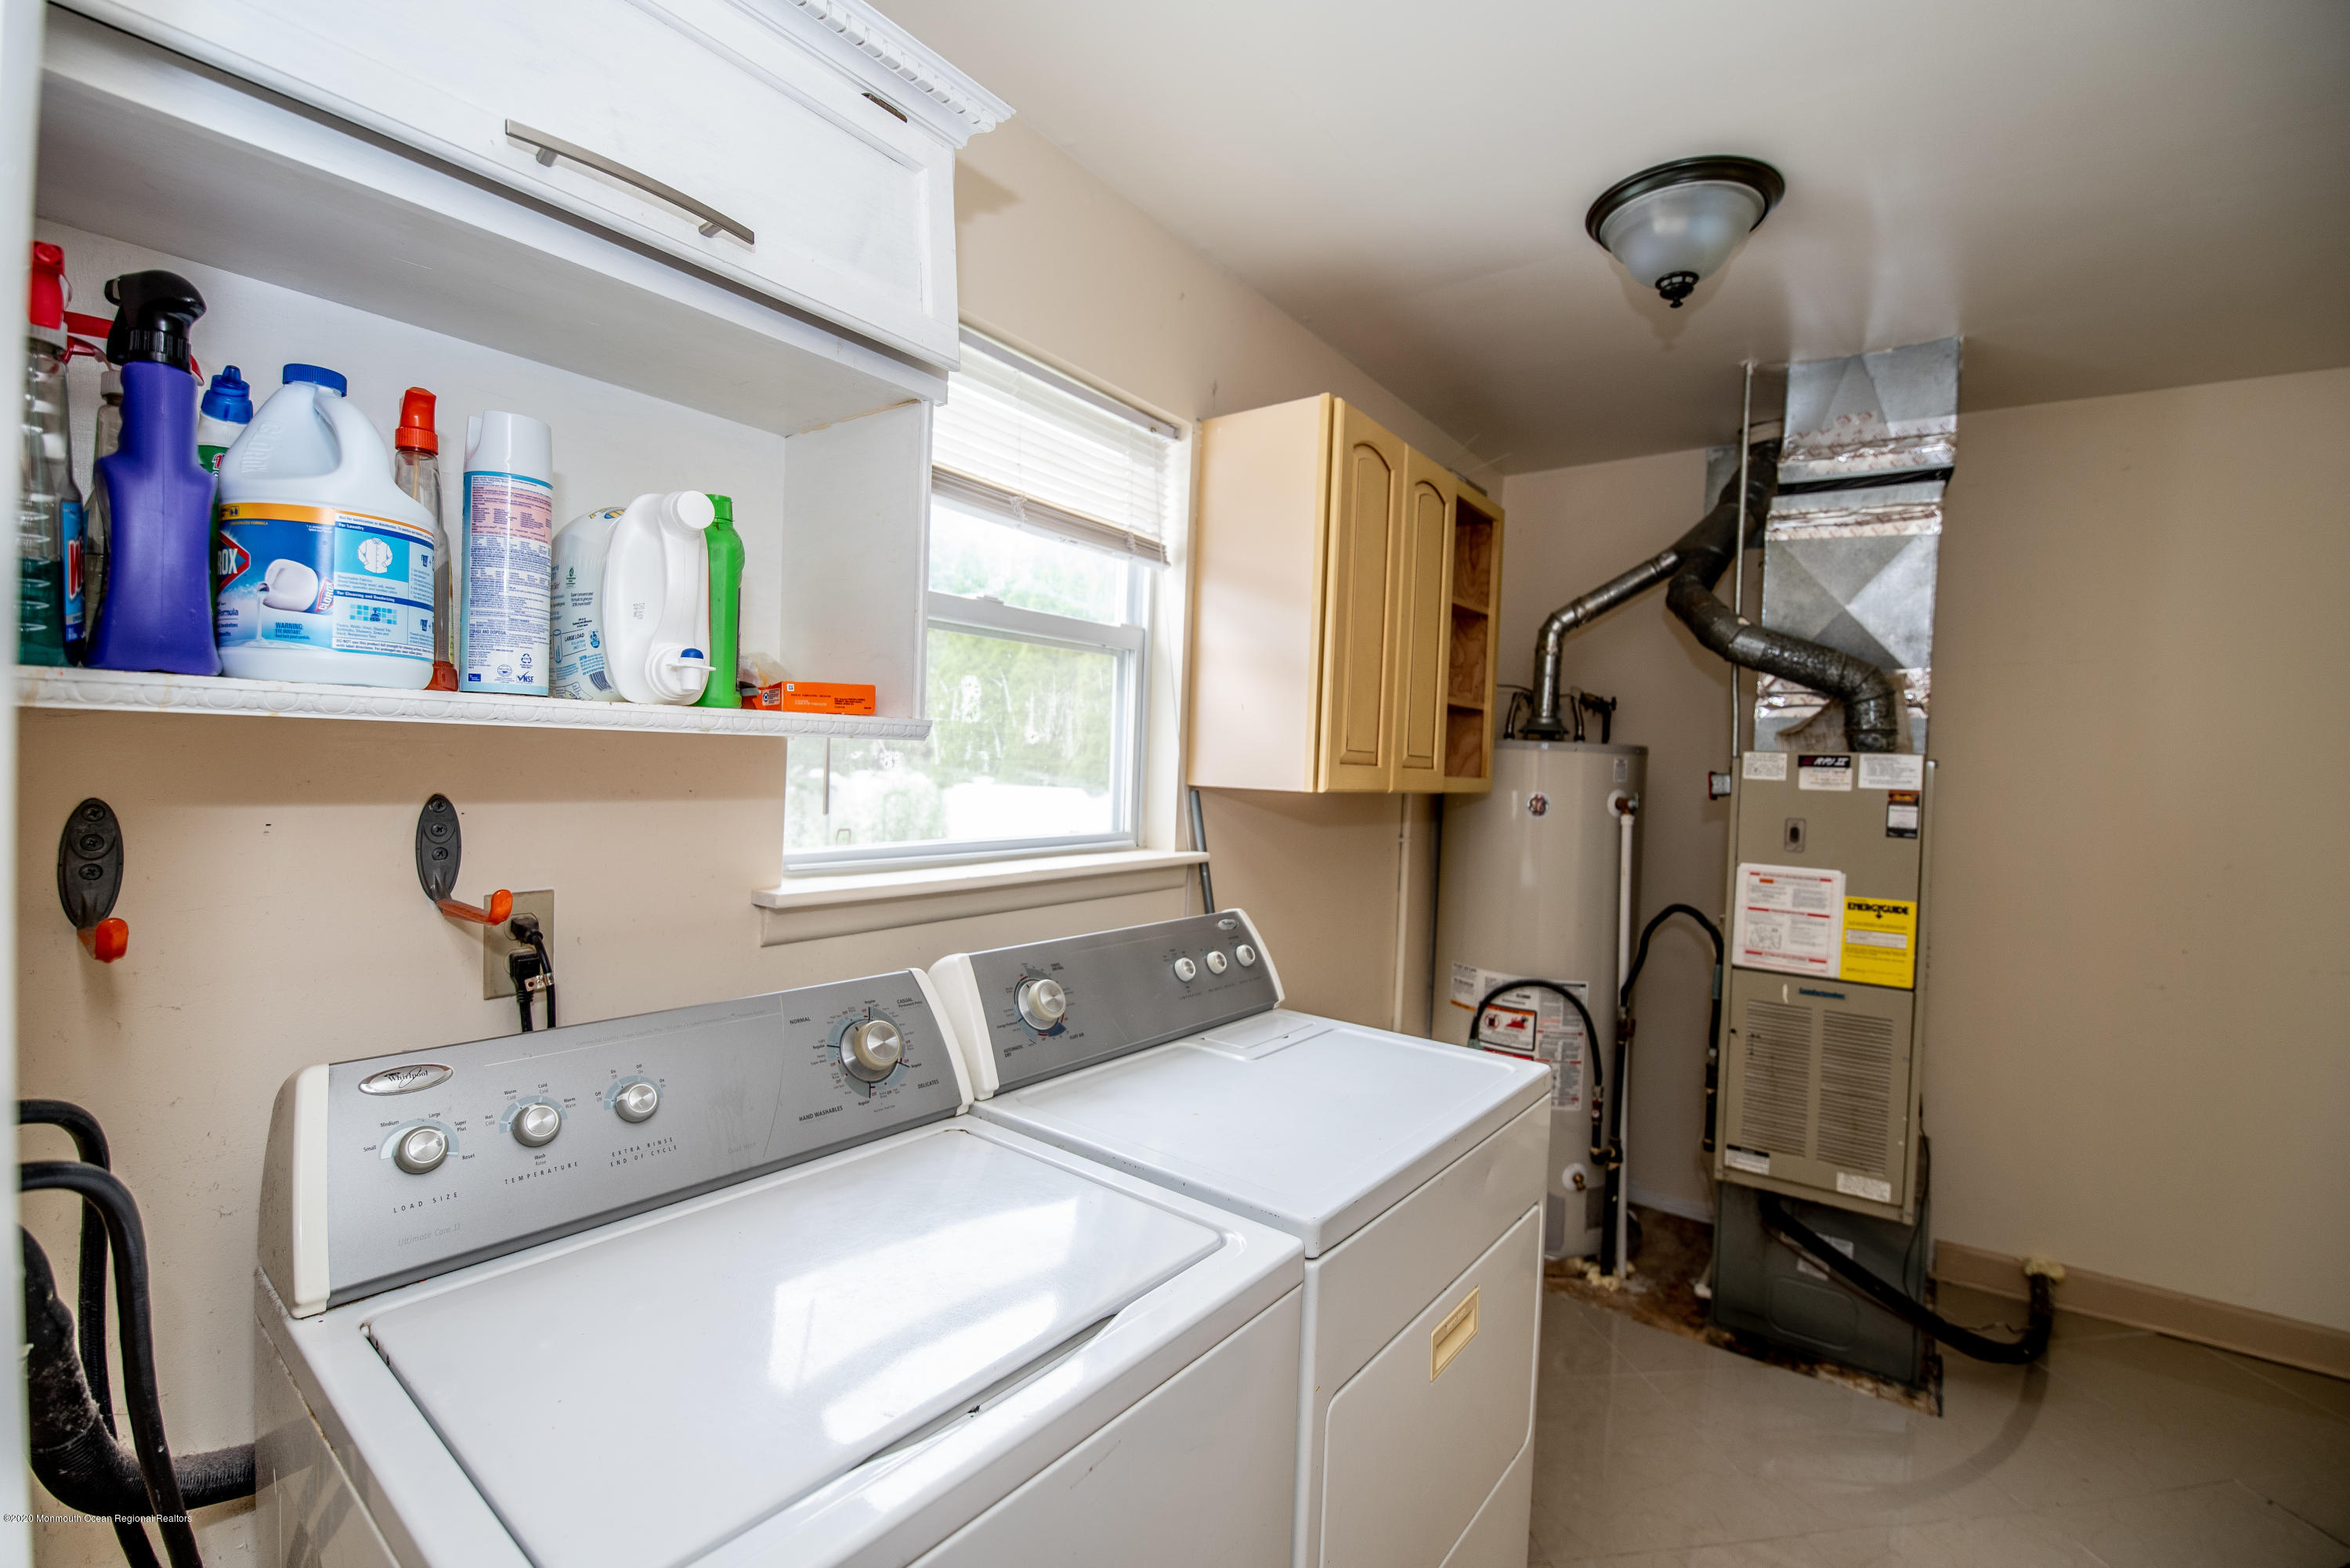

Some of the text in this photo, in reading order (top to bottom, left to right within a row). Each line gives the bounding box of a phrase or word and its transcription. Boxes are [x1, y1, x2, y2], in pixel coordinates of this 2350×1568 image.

[790, 1017, 812, 1026] NORMAL
[387, 1070, 429, 1083] Whirlpool
[917, 1078, 939, 1089] DELICATES
[428, 1111, 441, 1119] Large
[799, 1104, 844, 1122] HAND WASHABLES
[380, 1119, 400, 1129] Medium
[454, 1119, 468, 1129] Super
[363, 1144, 378, 1154] Small
[611, 1136, 675, 1158] EXTRA RINSE
[461, 1153, 476, 1162] Reset
[610, 1143, 679, 1168] END OF CYCLE
[504, 1161, 579, 1185] TEMPERATURE
[393, 1191, 458, 1213] LOAD SIZE
[397, 1233, 432, 1247] Ultimate
